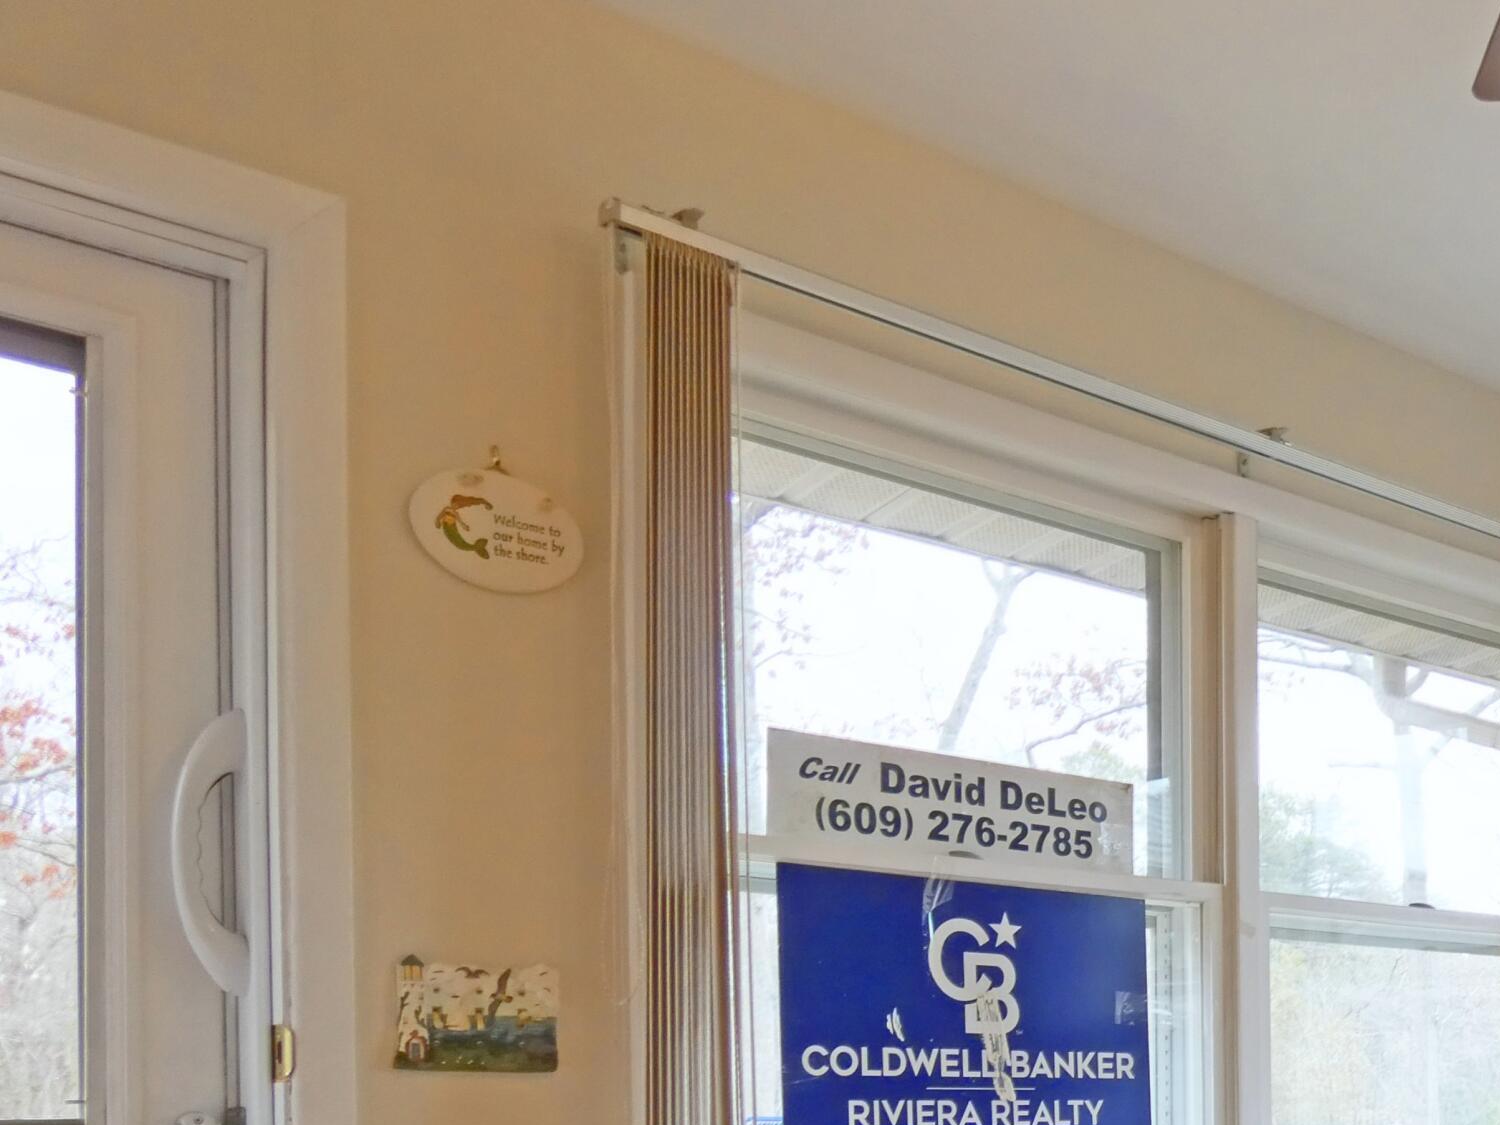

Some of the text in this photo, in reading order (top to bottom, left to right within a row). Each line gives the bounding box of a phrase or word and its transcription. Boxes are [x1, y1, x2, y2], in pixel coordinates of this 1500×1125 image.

[493, 514, 562, 538] Welcome to
[493, 532, 566, 557] our home by
[493, 543, 513, 559] the
[798, 756, 1108, 823] Call David DeLeo
[815, 796, 1093, 859] (609) 276-2785
[801, 1044, 1136, 1080] COLDWELL BANKER
